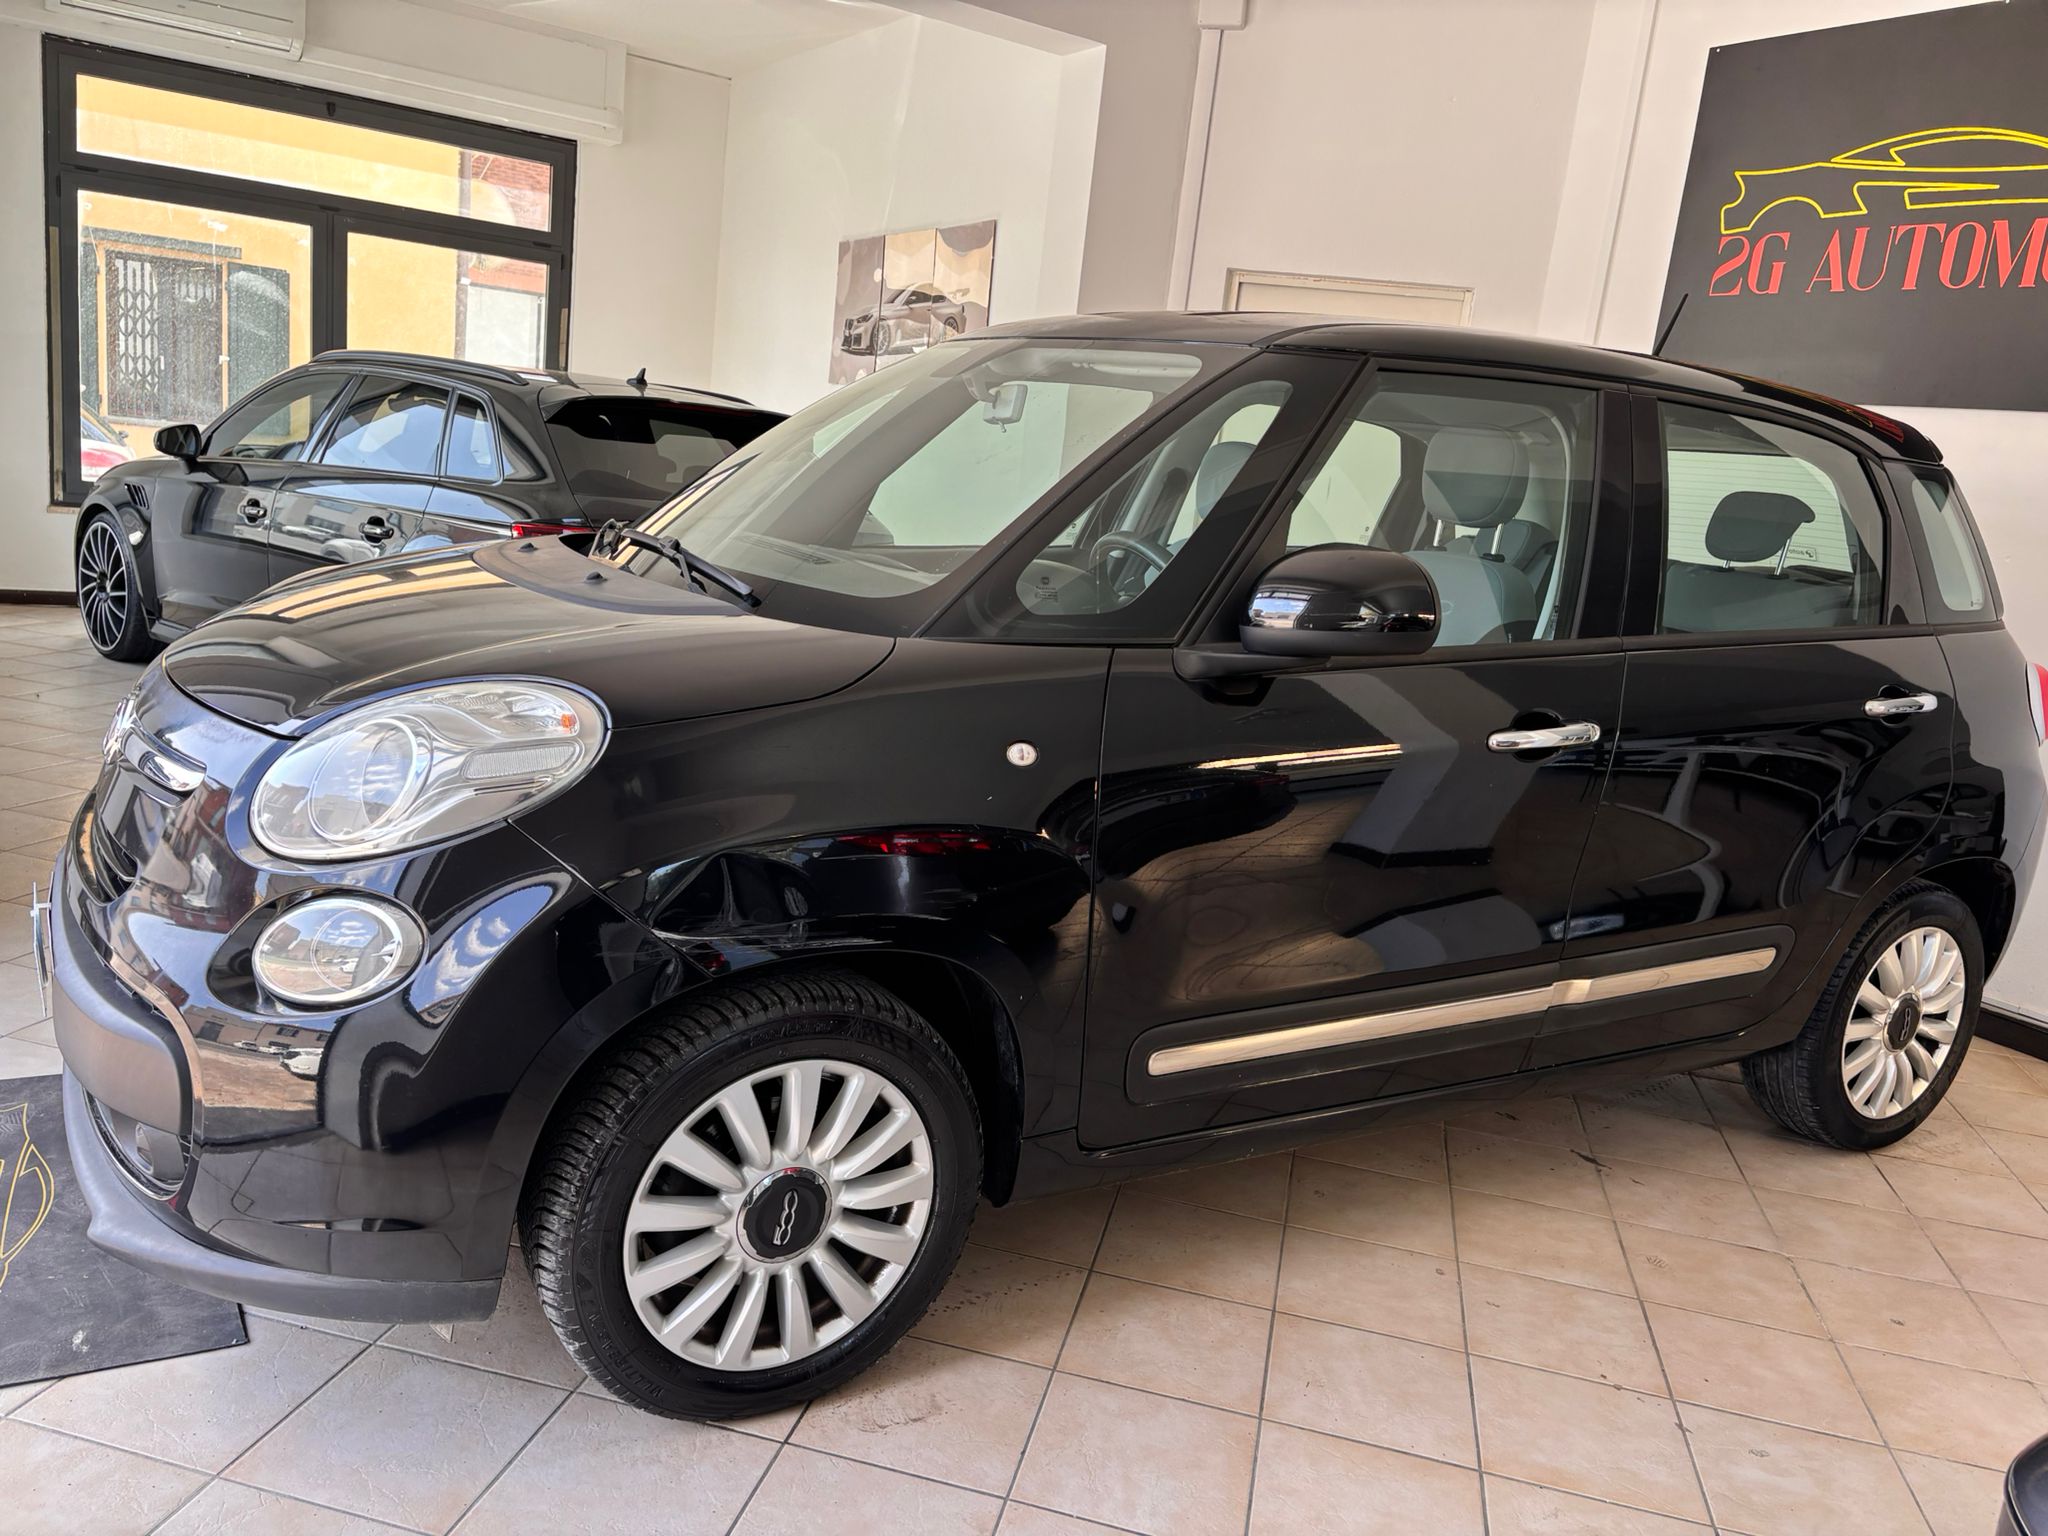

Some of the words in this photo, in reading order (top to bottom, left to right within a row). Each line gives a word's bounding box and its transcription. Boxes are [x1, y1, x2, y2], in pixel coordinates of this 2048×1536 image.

[1709, 231, 1791, 297] 2G
[1805, 217, 2048, 293] AUTOM
[1900, 1007, 1912, 1040] 500
[773, 1188, 799, 1245] 500
